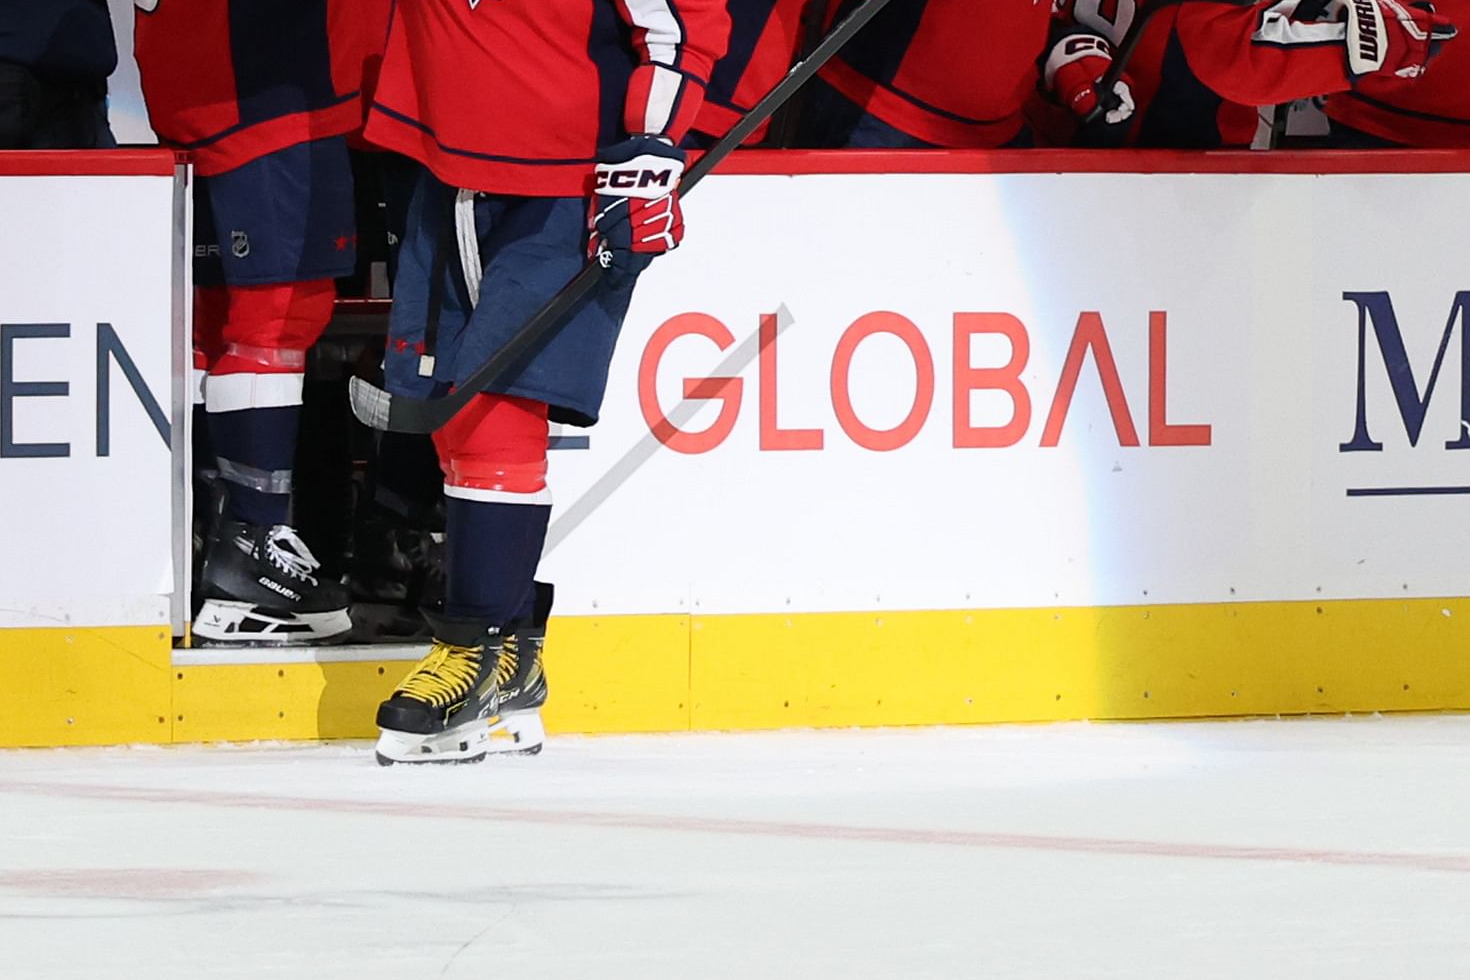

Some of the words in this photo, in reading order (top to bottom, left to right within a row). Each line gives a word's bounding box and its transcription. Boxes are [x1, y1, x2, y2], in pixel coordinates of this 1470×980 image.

[597, 169, 672, 188] CCM
[637, 309, 1213, 454] GLOBAL
[258, 576, 301, 602] BAUER
